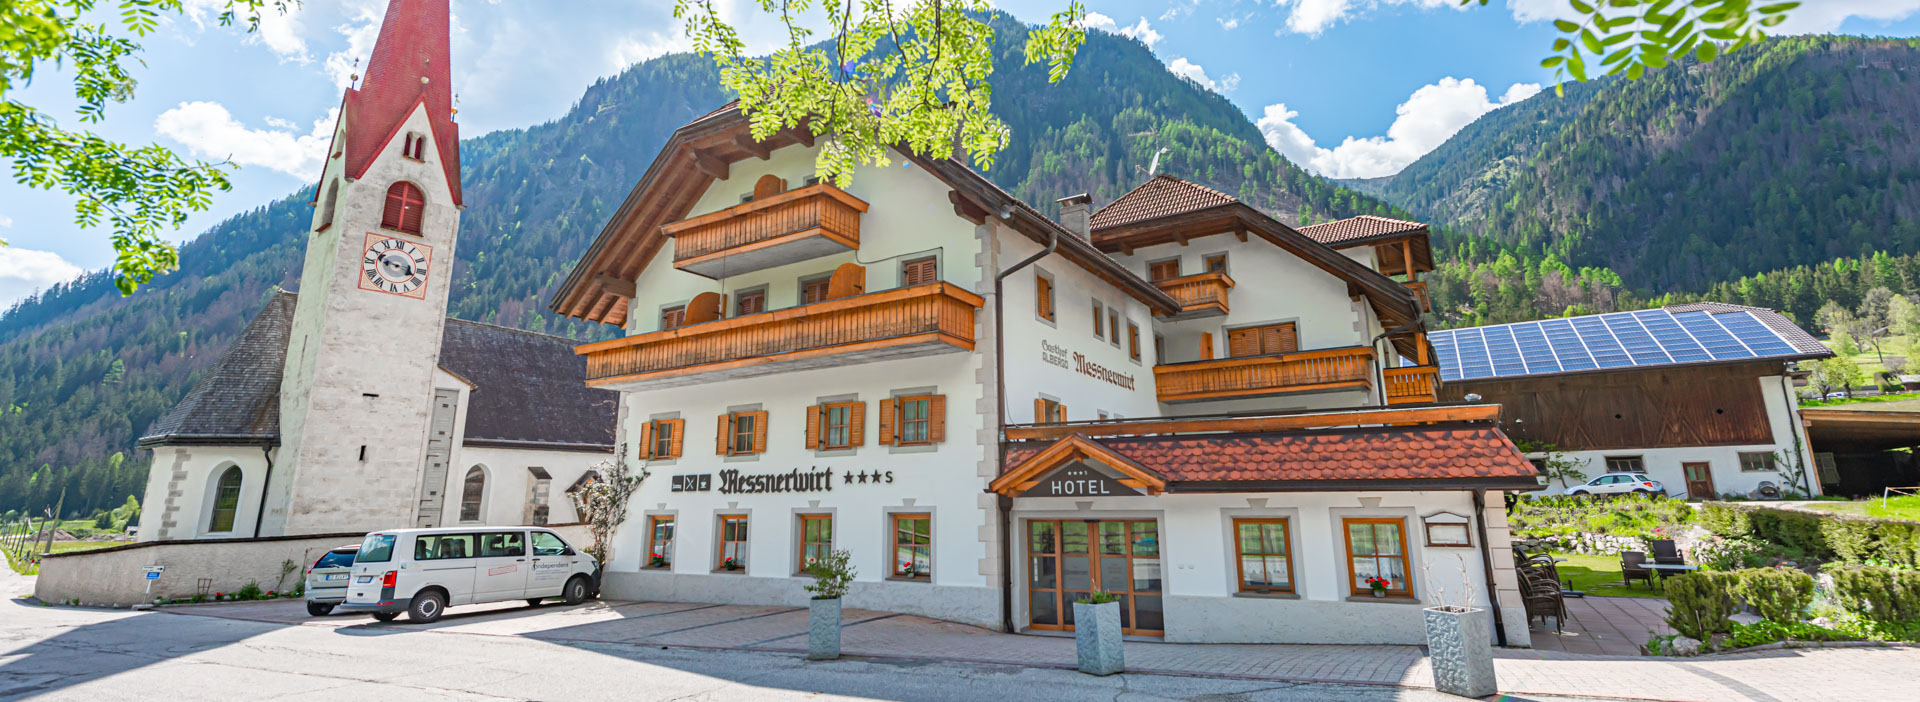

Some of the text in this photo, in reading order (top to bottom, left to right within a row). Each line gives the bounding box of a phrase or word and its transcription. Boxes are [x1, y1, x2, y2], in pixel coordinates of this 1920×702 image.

[395, 240, 405, 250] XII
[1042, 340, 1068, 359] Gasthof
[1073, 351, 1135, 392] Messnerwirt
[718, 466, 833, 495] Messnerwirt
[1052, 480, 1110, 495] HOTEL
